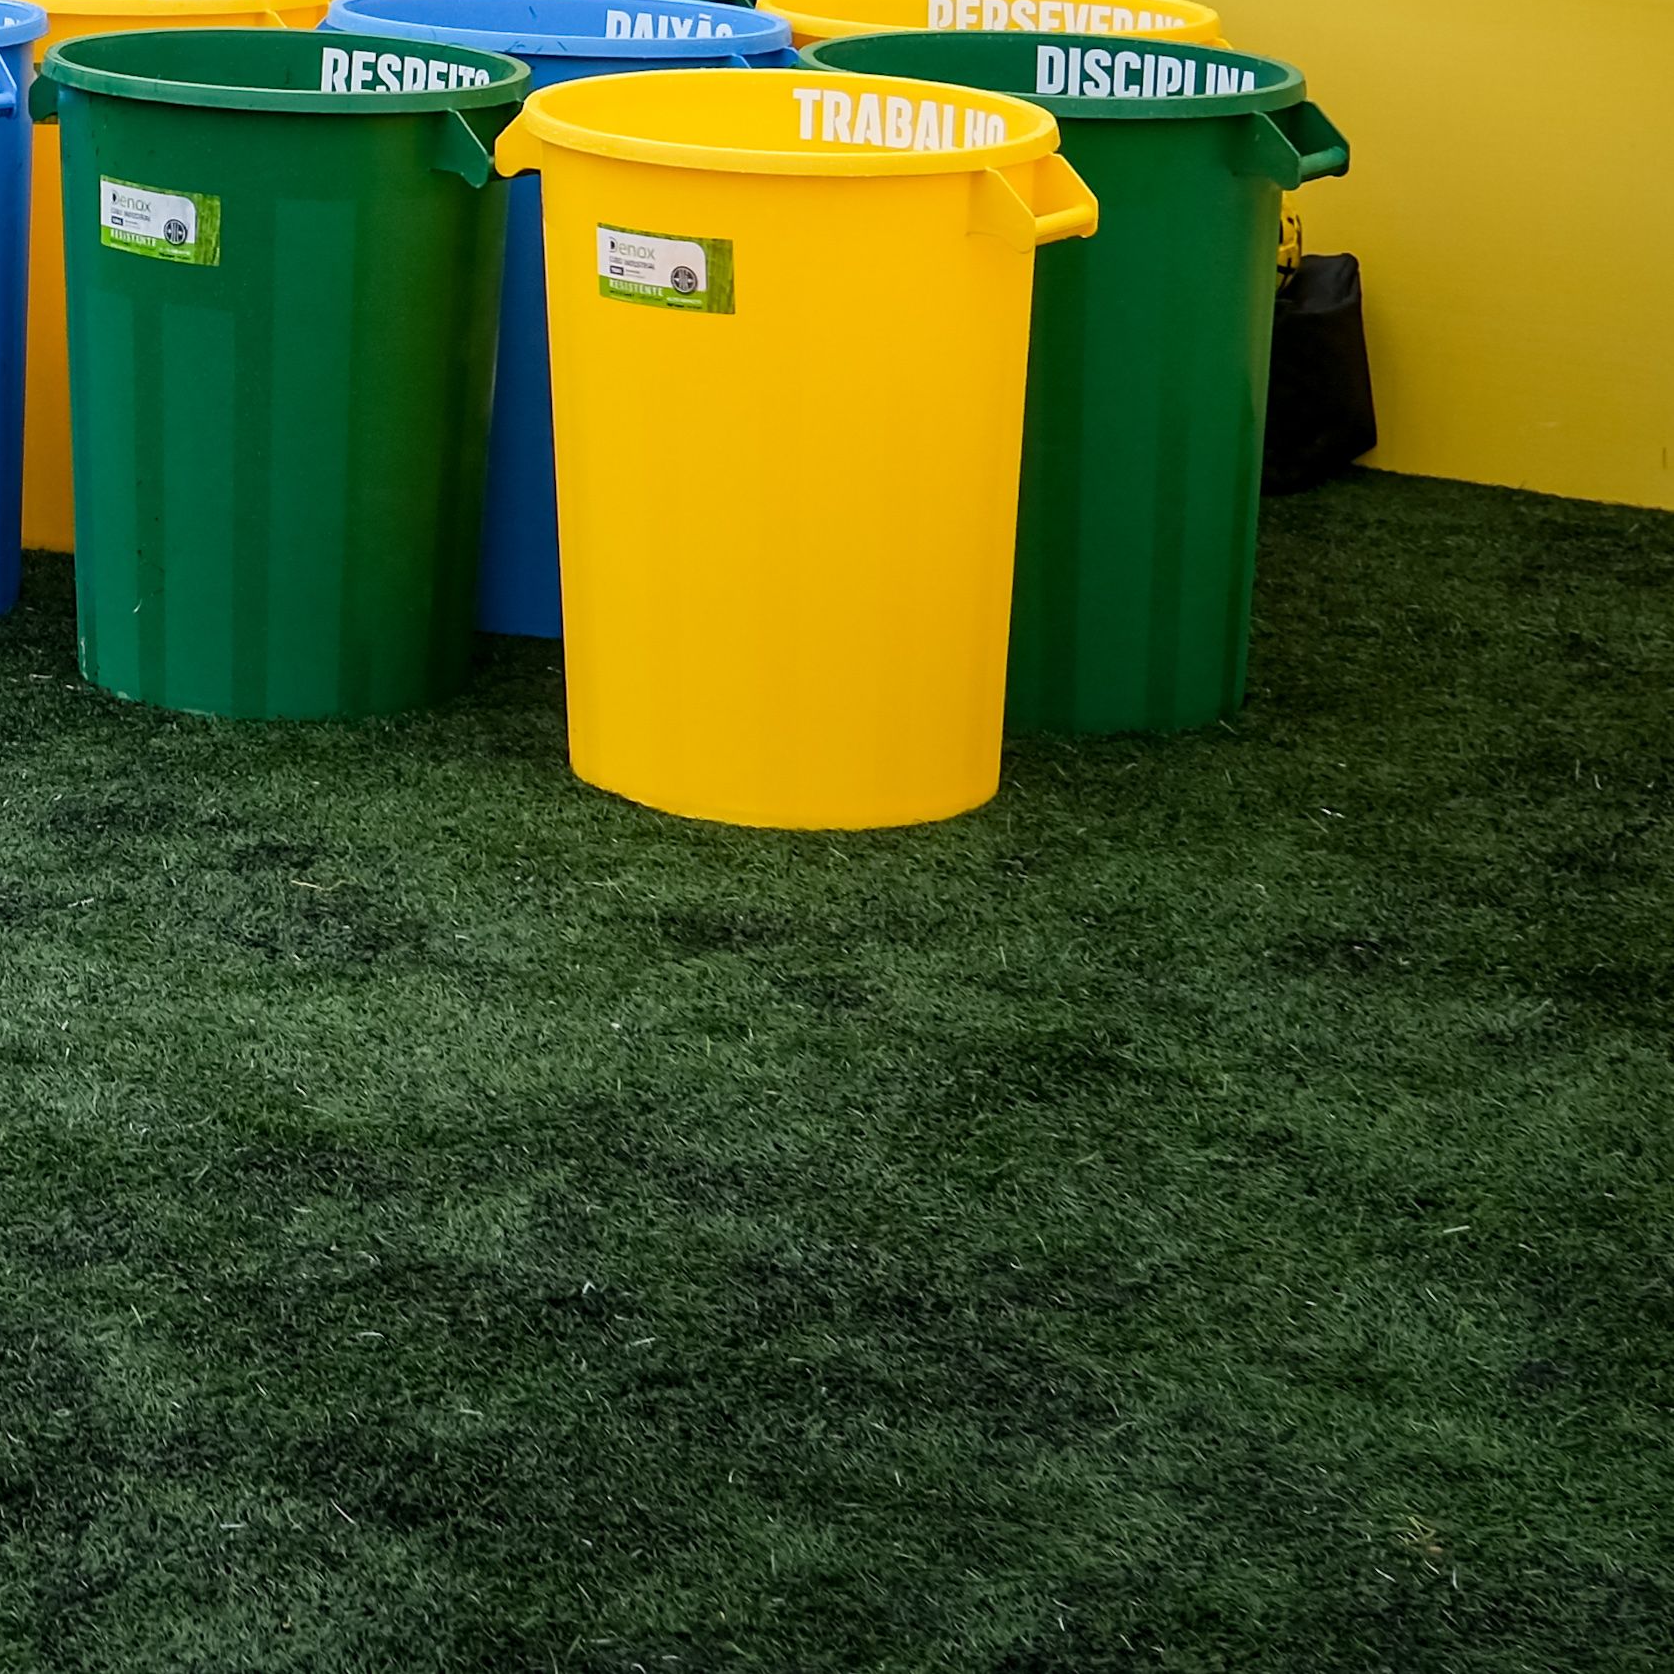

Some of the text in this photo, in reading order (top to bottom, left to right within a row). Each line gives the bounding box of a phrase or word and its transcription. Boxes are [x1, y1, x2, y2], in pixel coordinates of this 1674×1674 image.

[792, 87, 1006, 152] TRABALHO
[111, 190, 151, 212] Denox
[609, 236, 656, 260] Denox
[609, 279, 664, 297] RESISTENTE
